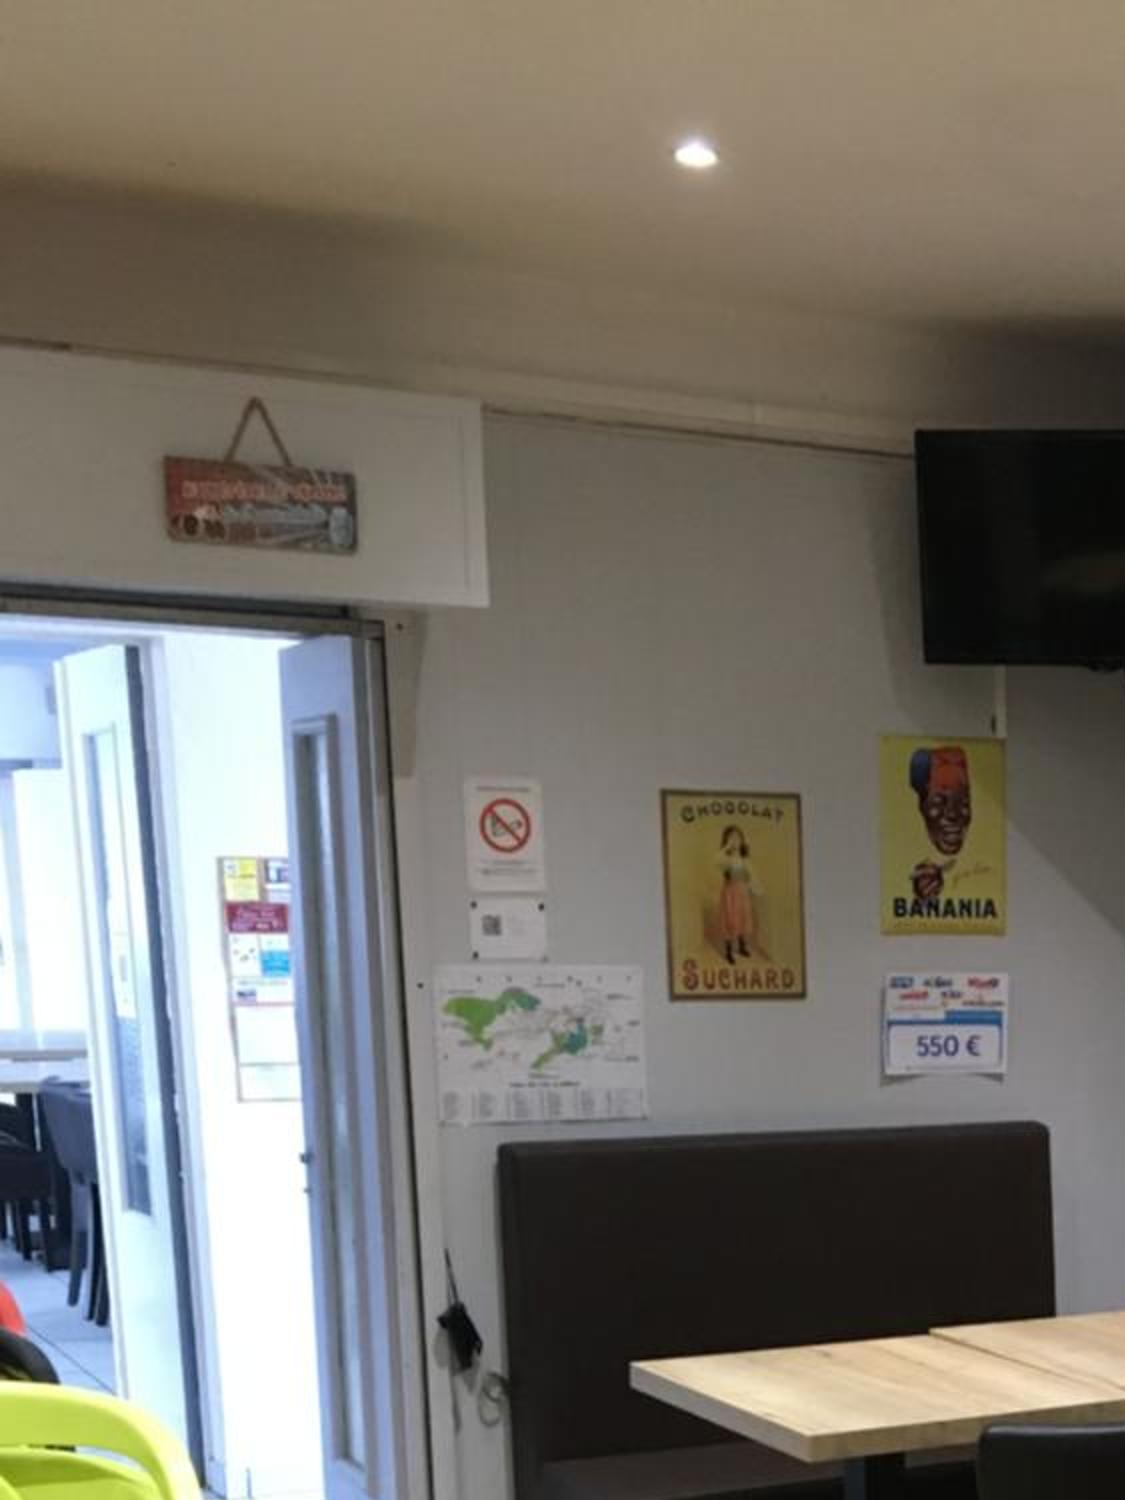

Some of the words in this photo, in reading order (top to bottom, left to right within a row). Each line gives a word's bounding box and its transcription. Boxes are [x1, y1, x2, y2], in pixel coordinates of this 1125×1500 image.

[680, 802, 785, 823] CHOCOLAT
[893, 896, 998, 919] BANANIA
[682, 958, 796, 991] SUCHARD
[916, 1034, 960, 1057] 550
[966, 1034, 982, 1057] €
